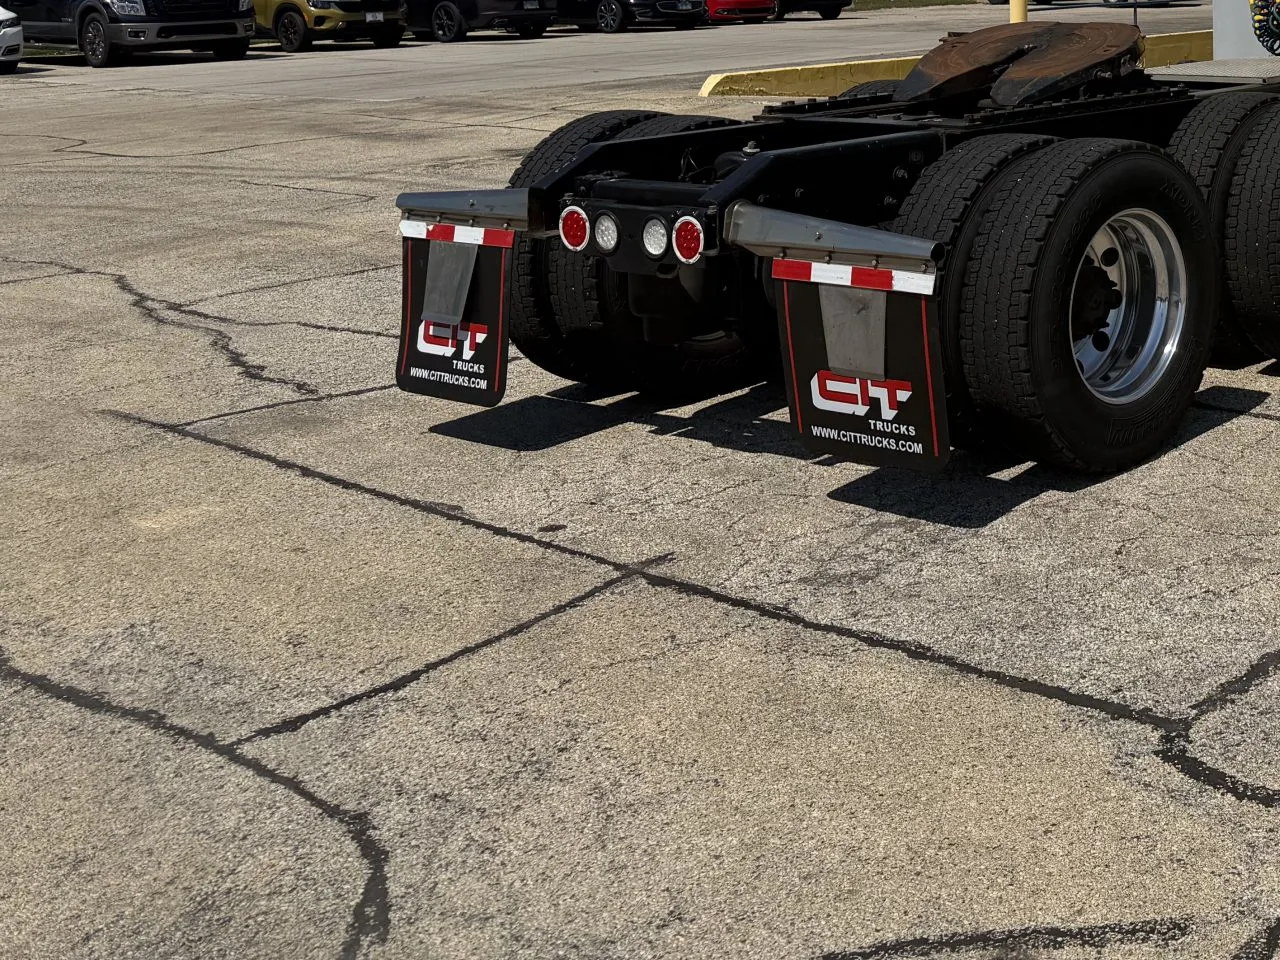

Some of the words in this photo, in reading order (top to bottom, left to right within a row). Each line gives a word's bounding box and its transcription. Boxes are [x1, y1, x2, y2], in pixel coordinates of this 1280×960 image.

[410, 366, 488, 390] WWW.CITTRUCKS.COM
[452, 360, 485, 374] TRUCKS
[810, 369, 913, 421] CIT
[811, 425, 923, 454] WWW.CITTRUCKS.COM
[868, 419, 917, 436] TRUCKS
